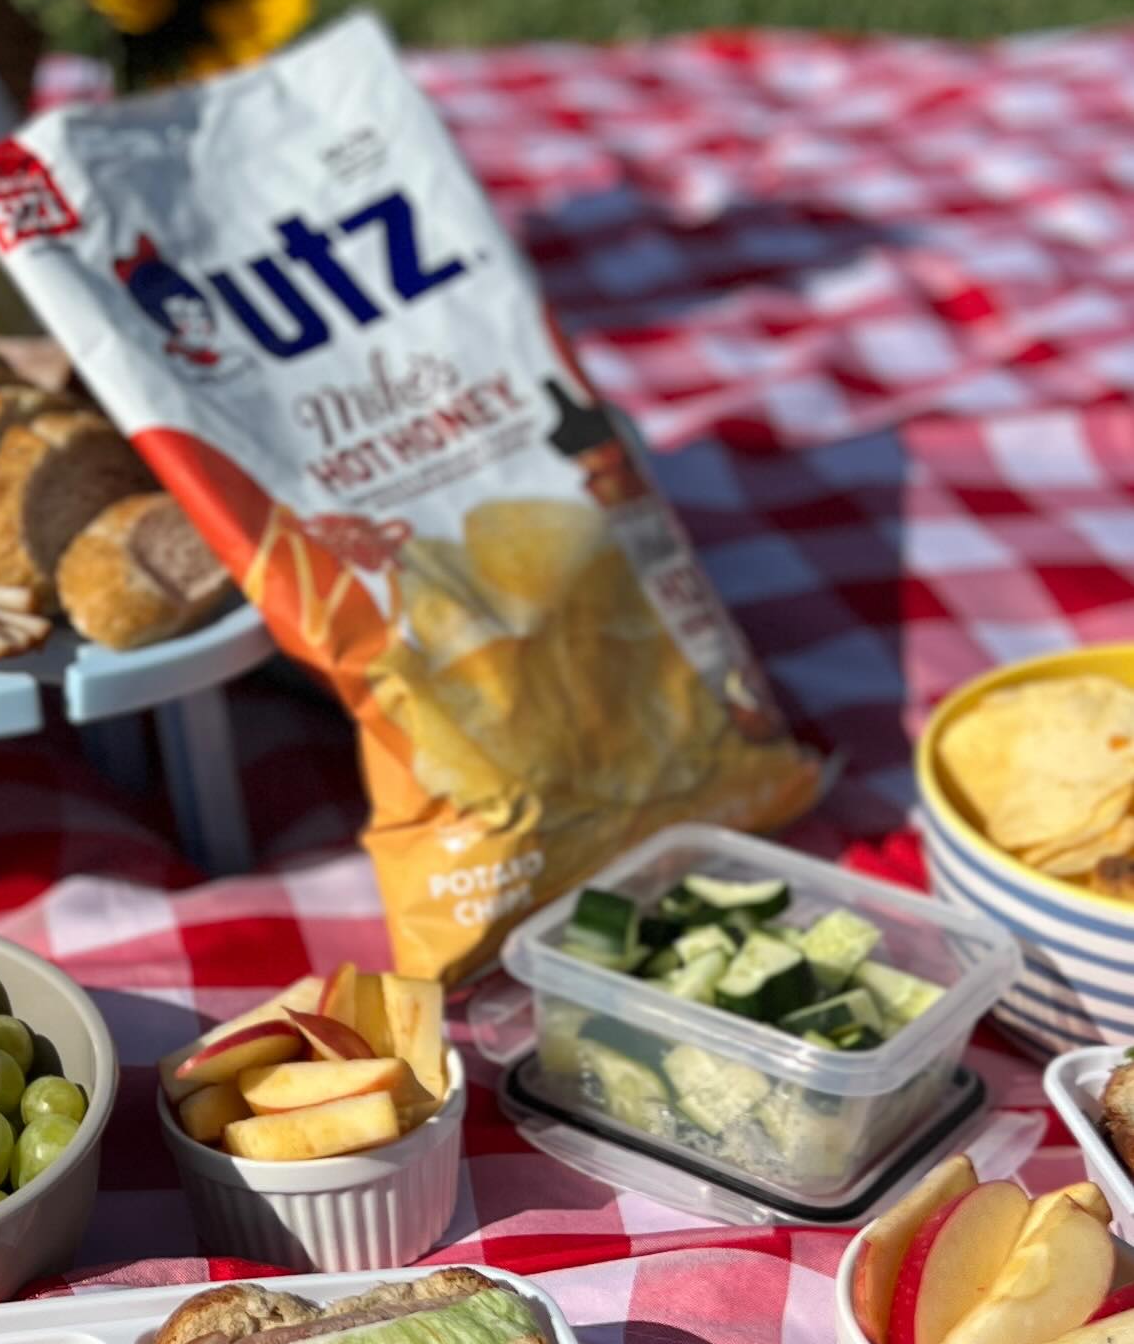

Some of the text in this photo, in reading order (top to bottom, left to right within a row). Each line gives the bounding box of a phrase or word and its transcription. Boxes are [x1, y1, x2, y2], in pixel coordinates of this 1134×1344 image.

[208, 191, 468, 359] utz
[305, 438, 396, 494] HOT
[382, 370, 524, 464] HONEY
[428, 848, 545, 902] POTATO
